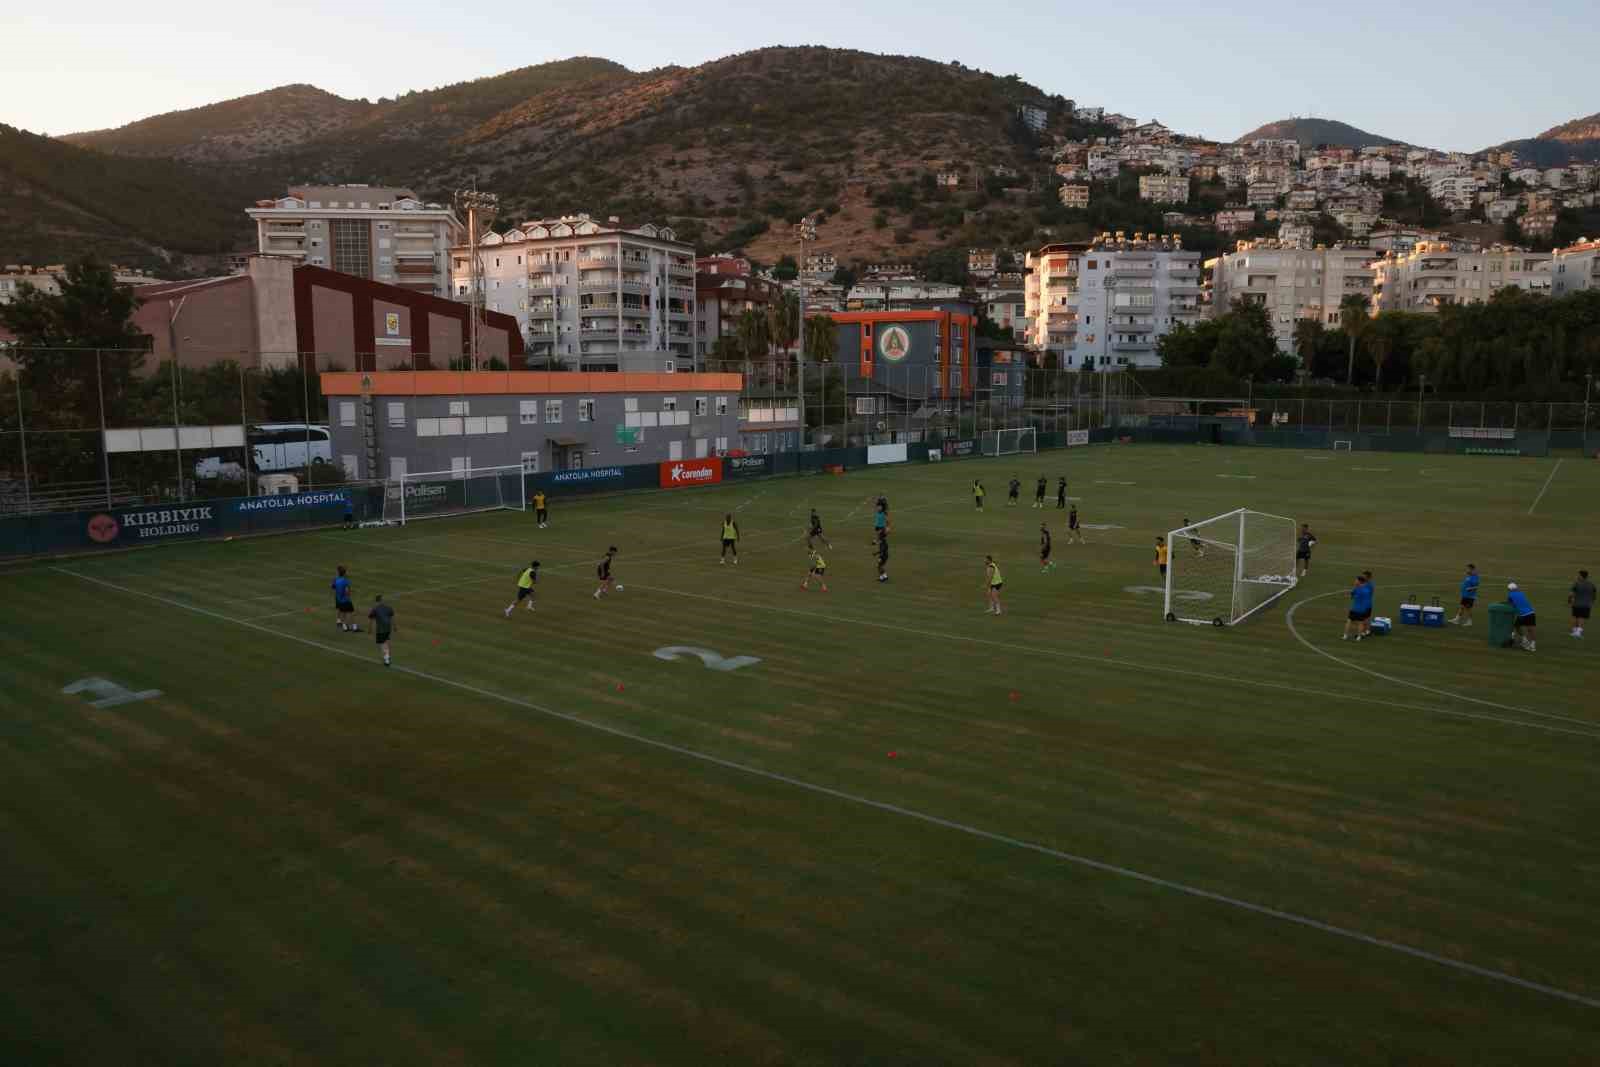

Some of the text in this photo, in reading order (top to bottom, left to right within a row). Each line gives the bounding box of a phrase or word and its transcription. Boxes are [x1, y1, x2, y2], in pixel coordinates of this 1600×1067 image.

[239, 492, 345, 511] ANATOLIA HOSPITAL
[122, 507, 212, 527] KIRBIYIK
[140, 522, 200, 538] HOLDING
